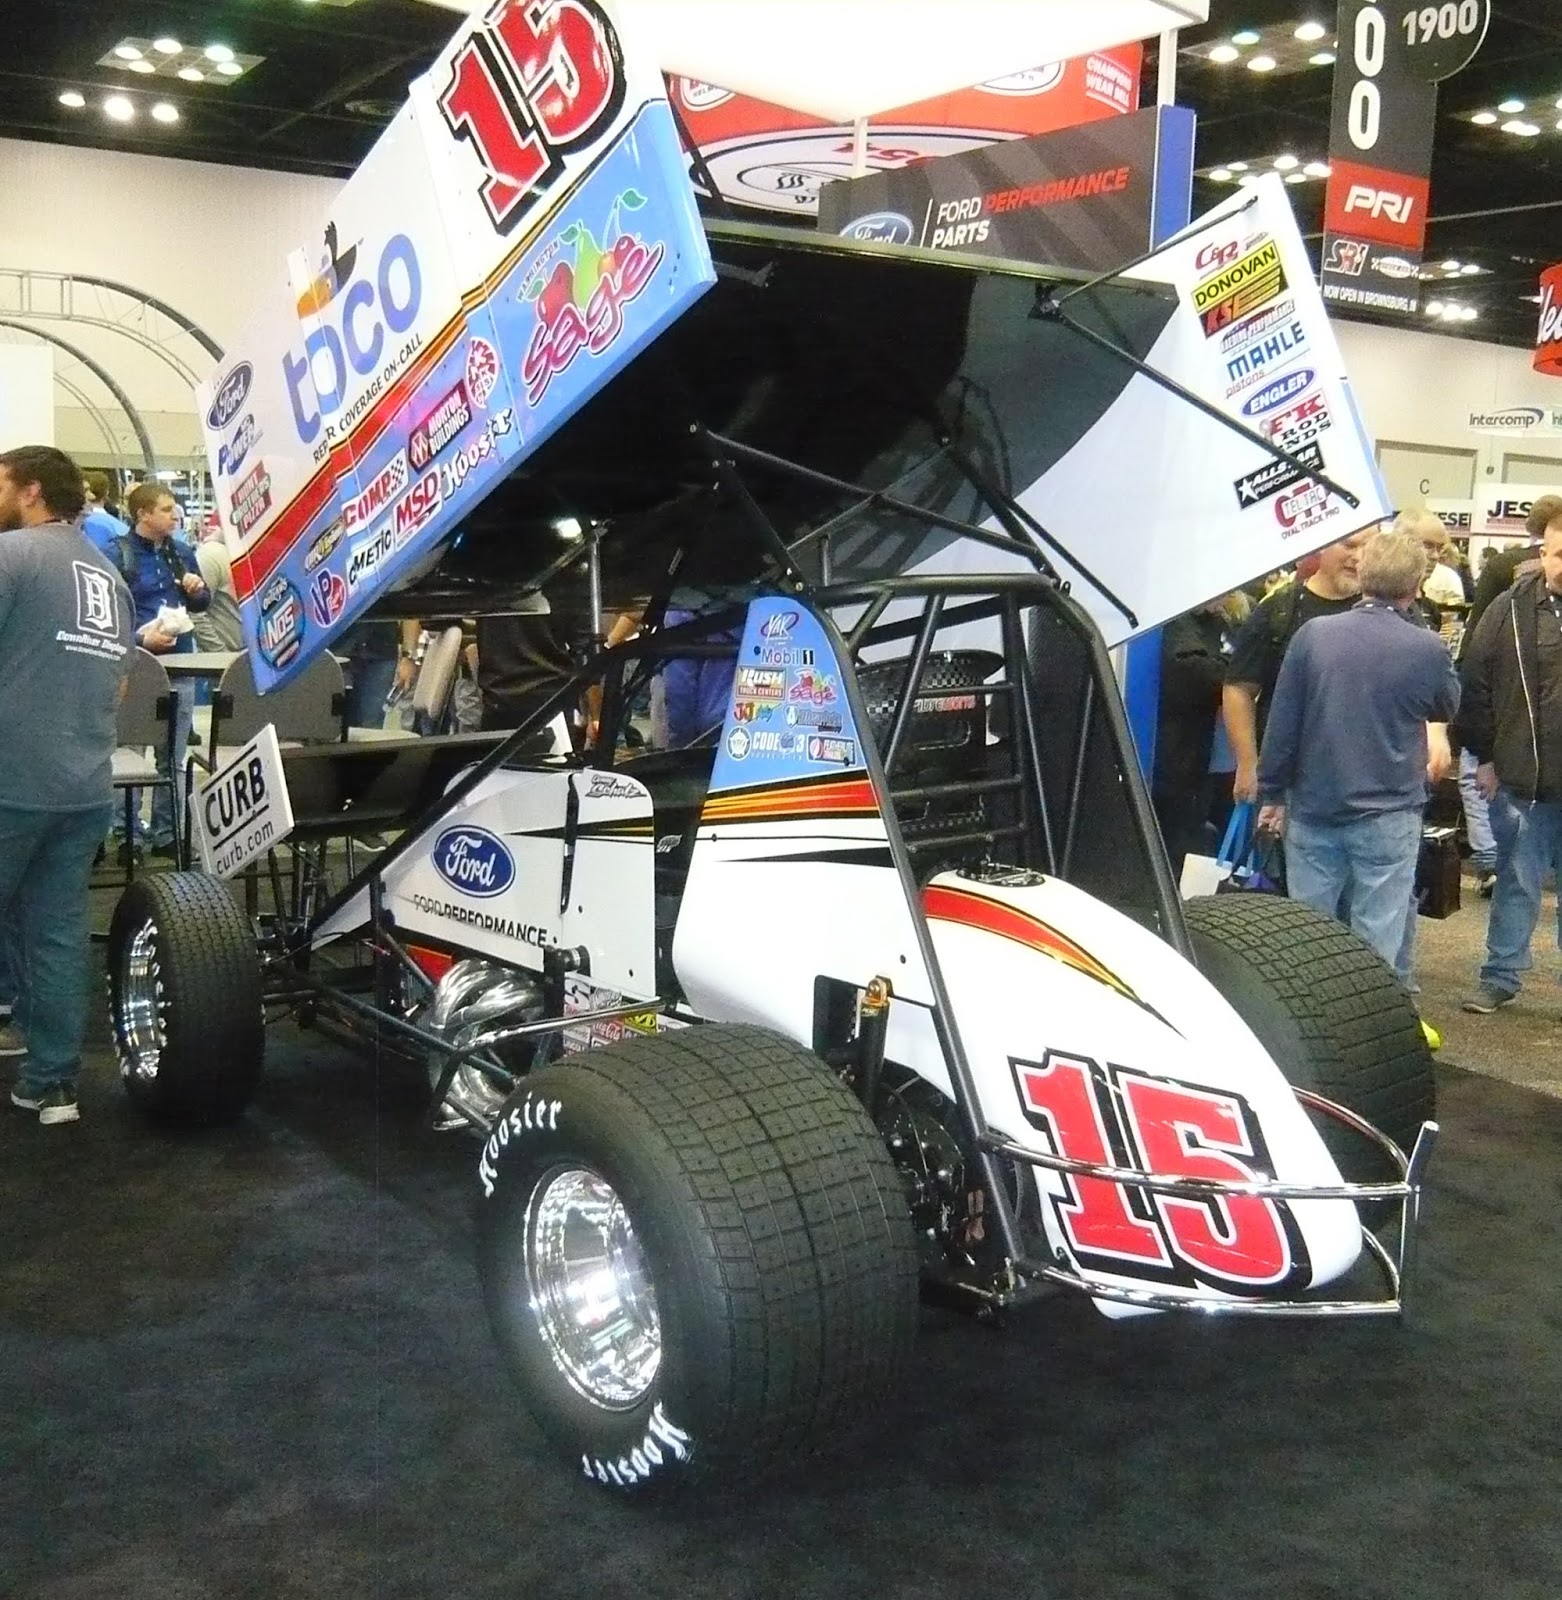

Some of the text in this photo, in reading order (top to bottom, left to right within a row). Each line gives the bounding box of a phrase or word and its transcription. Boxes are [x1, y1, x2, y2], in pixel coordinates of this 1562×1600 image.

[1402, 0, 1479, 46] 1900
[436, 0, 627, 237] 15
[936, 166, 1130, 225] FORD PERFORMANCE
[1344, 185, 1413, 224] PRI
[932, 219, 990, 249] PARTS
[1195, 246, 1277, 307] DONOVAN
[1226, 321, 1306, 382] MAHLE
[217, 373, 248, 423] Ford
[313, 332, 423, 464] REPR COVERAGE ON-CALL
[1226, 369, 1265, 399] pistons
[1250, 371, 1309, 415] ENGLER
[428, 389, 462, 436] MORTON
[429, 405, 471, 456] BUILDINGS
[1270, 394, 1325, 436] FK
[1281, 411, 1328, 442] ROD
[1469, 412, 1535, 428] Intercomp
[1252, 446, 1317, 487] ALLSAR
[1419, 479, 1430, 495] C
[396, 470, 440, 534] MSD
[1281, 506, 1341, 540] OVAL TRACK PRO
[1487, 500, 1533, 519] JES
[310, 568, 333, 626] VP
[265, 596, 295, 650] NOS
[740, 669, 783, 688] RUSH
[761, 648, 799, 665] Mobil
[752, 731, 780, 750] CODE
[205, 757, 266, 838] CURB
[216, 820, 275, 875] curb.com
[445, 834, 496, 887] Ford
[413, 893, 548, 948] FORD PERFORMANCE
[1007, 1046, 1314, 1296] 15
